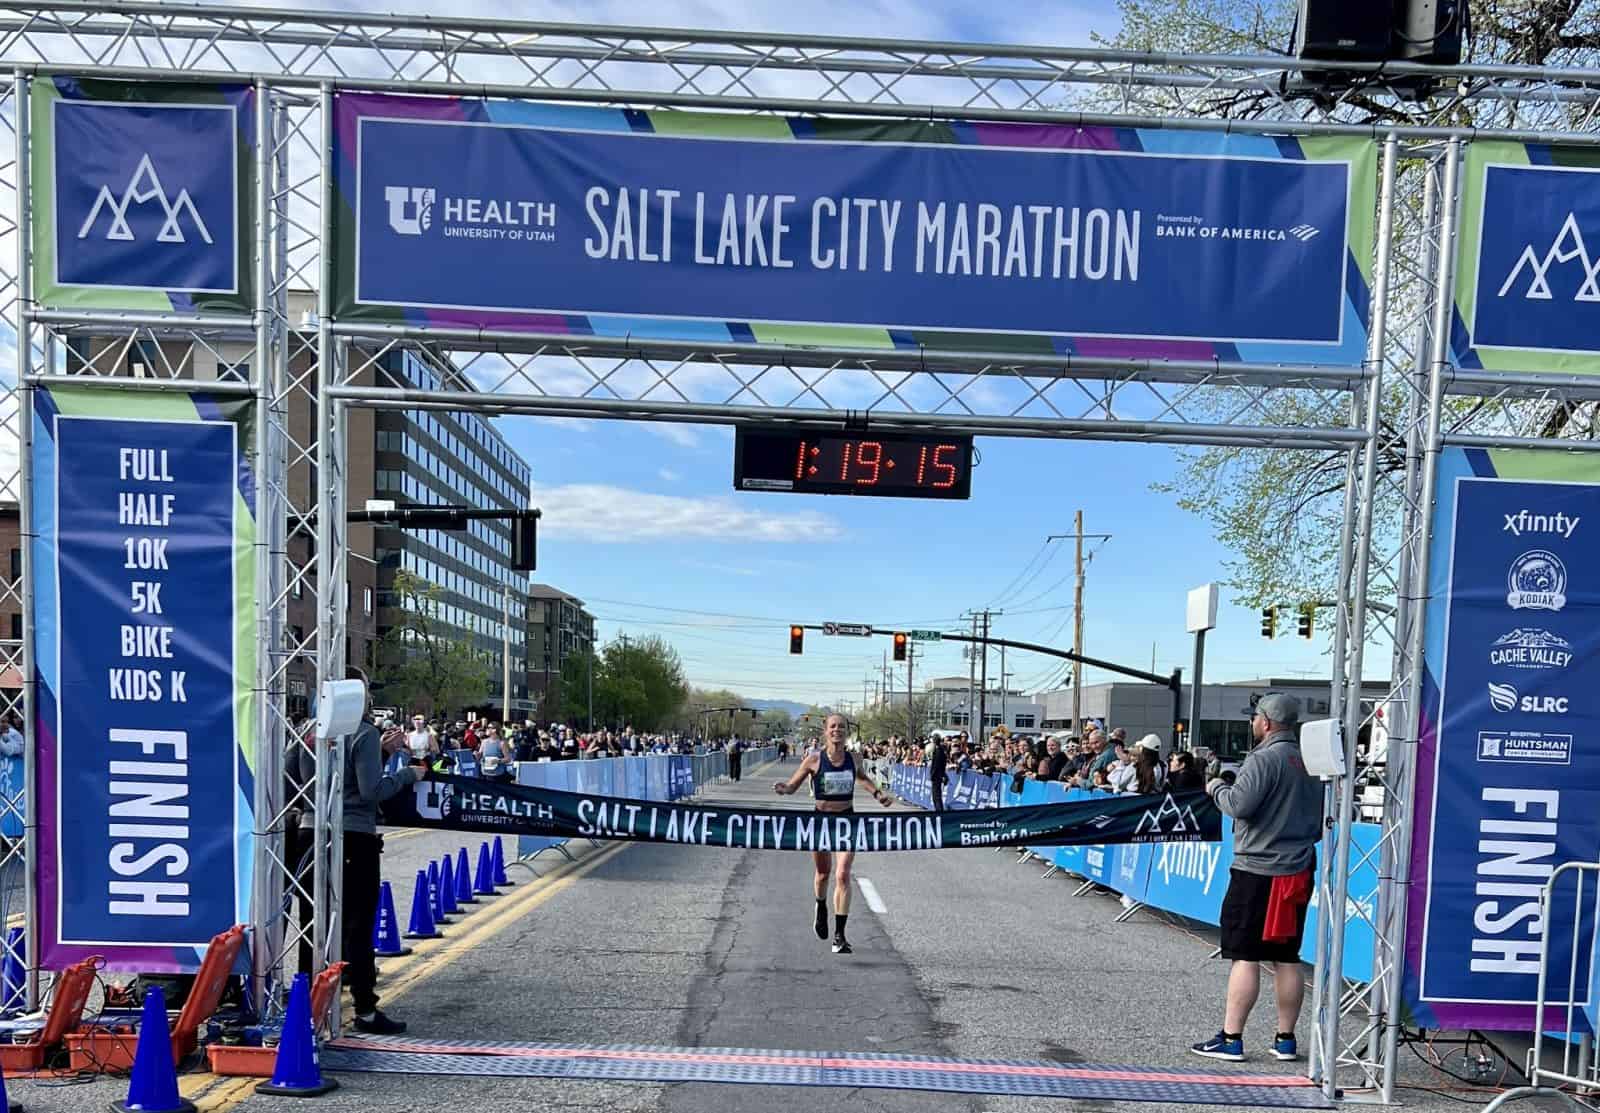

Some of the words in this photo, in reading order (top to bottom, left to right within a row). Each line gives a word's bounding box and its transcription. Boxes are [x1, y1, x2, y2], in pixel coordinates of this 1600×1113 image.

[444, 198, 556, 226] HEALTH
[444, 227, 505, 240] UNIVERSITY
[508, 229, 523, 240] OF
[526, 230, 556, 242] UTAH
[584, 186, 681, 262] SALT
[695, 192, 796, 268] LAKE
[810, 197, 901, 271] CITY
[916, 201, 1140, 281] MARATHON
[1156, 225, 1196, 237] BANK
[1200, 227, 1218, 238] OF
[1222, 228, 1286, 241] AMERICA
[119, 447, 174, 482] FULL
[119, 493, 175, 526] HALF
[1503, 509, 1580, 538] xfinity
[124, 537, 169, 570] 10K
[131, 581, 162, 614] 5K
[1519, 593, 1555, 606] KODIAK
[121, 625, 174, 658] BIKE
[1490, 648, 1527, 665] CACHE
[1530, 649, 1573, 667] VALLEY
[109, 668, 162, 701] KIDS
[171, 671, 187, 702] K
[1521, 696, 1569, 713] SLRC
[1504, 739, 1568, 750] HUNTSMAN
[461, 791, 553, 819] HEALTH
[109, 728, 190, 916] FINISH
[578, 799, 642, 836] SALT
[727, 814, 786, 849] CITY
[796, 816, 943, 852] MARATHON
[960, 830, 999, 846] Bank
[1470, 787, 1560, 974] FINISH
